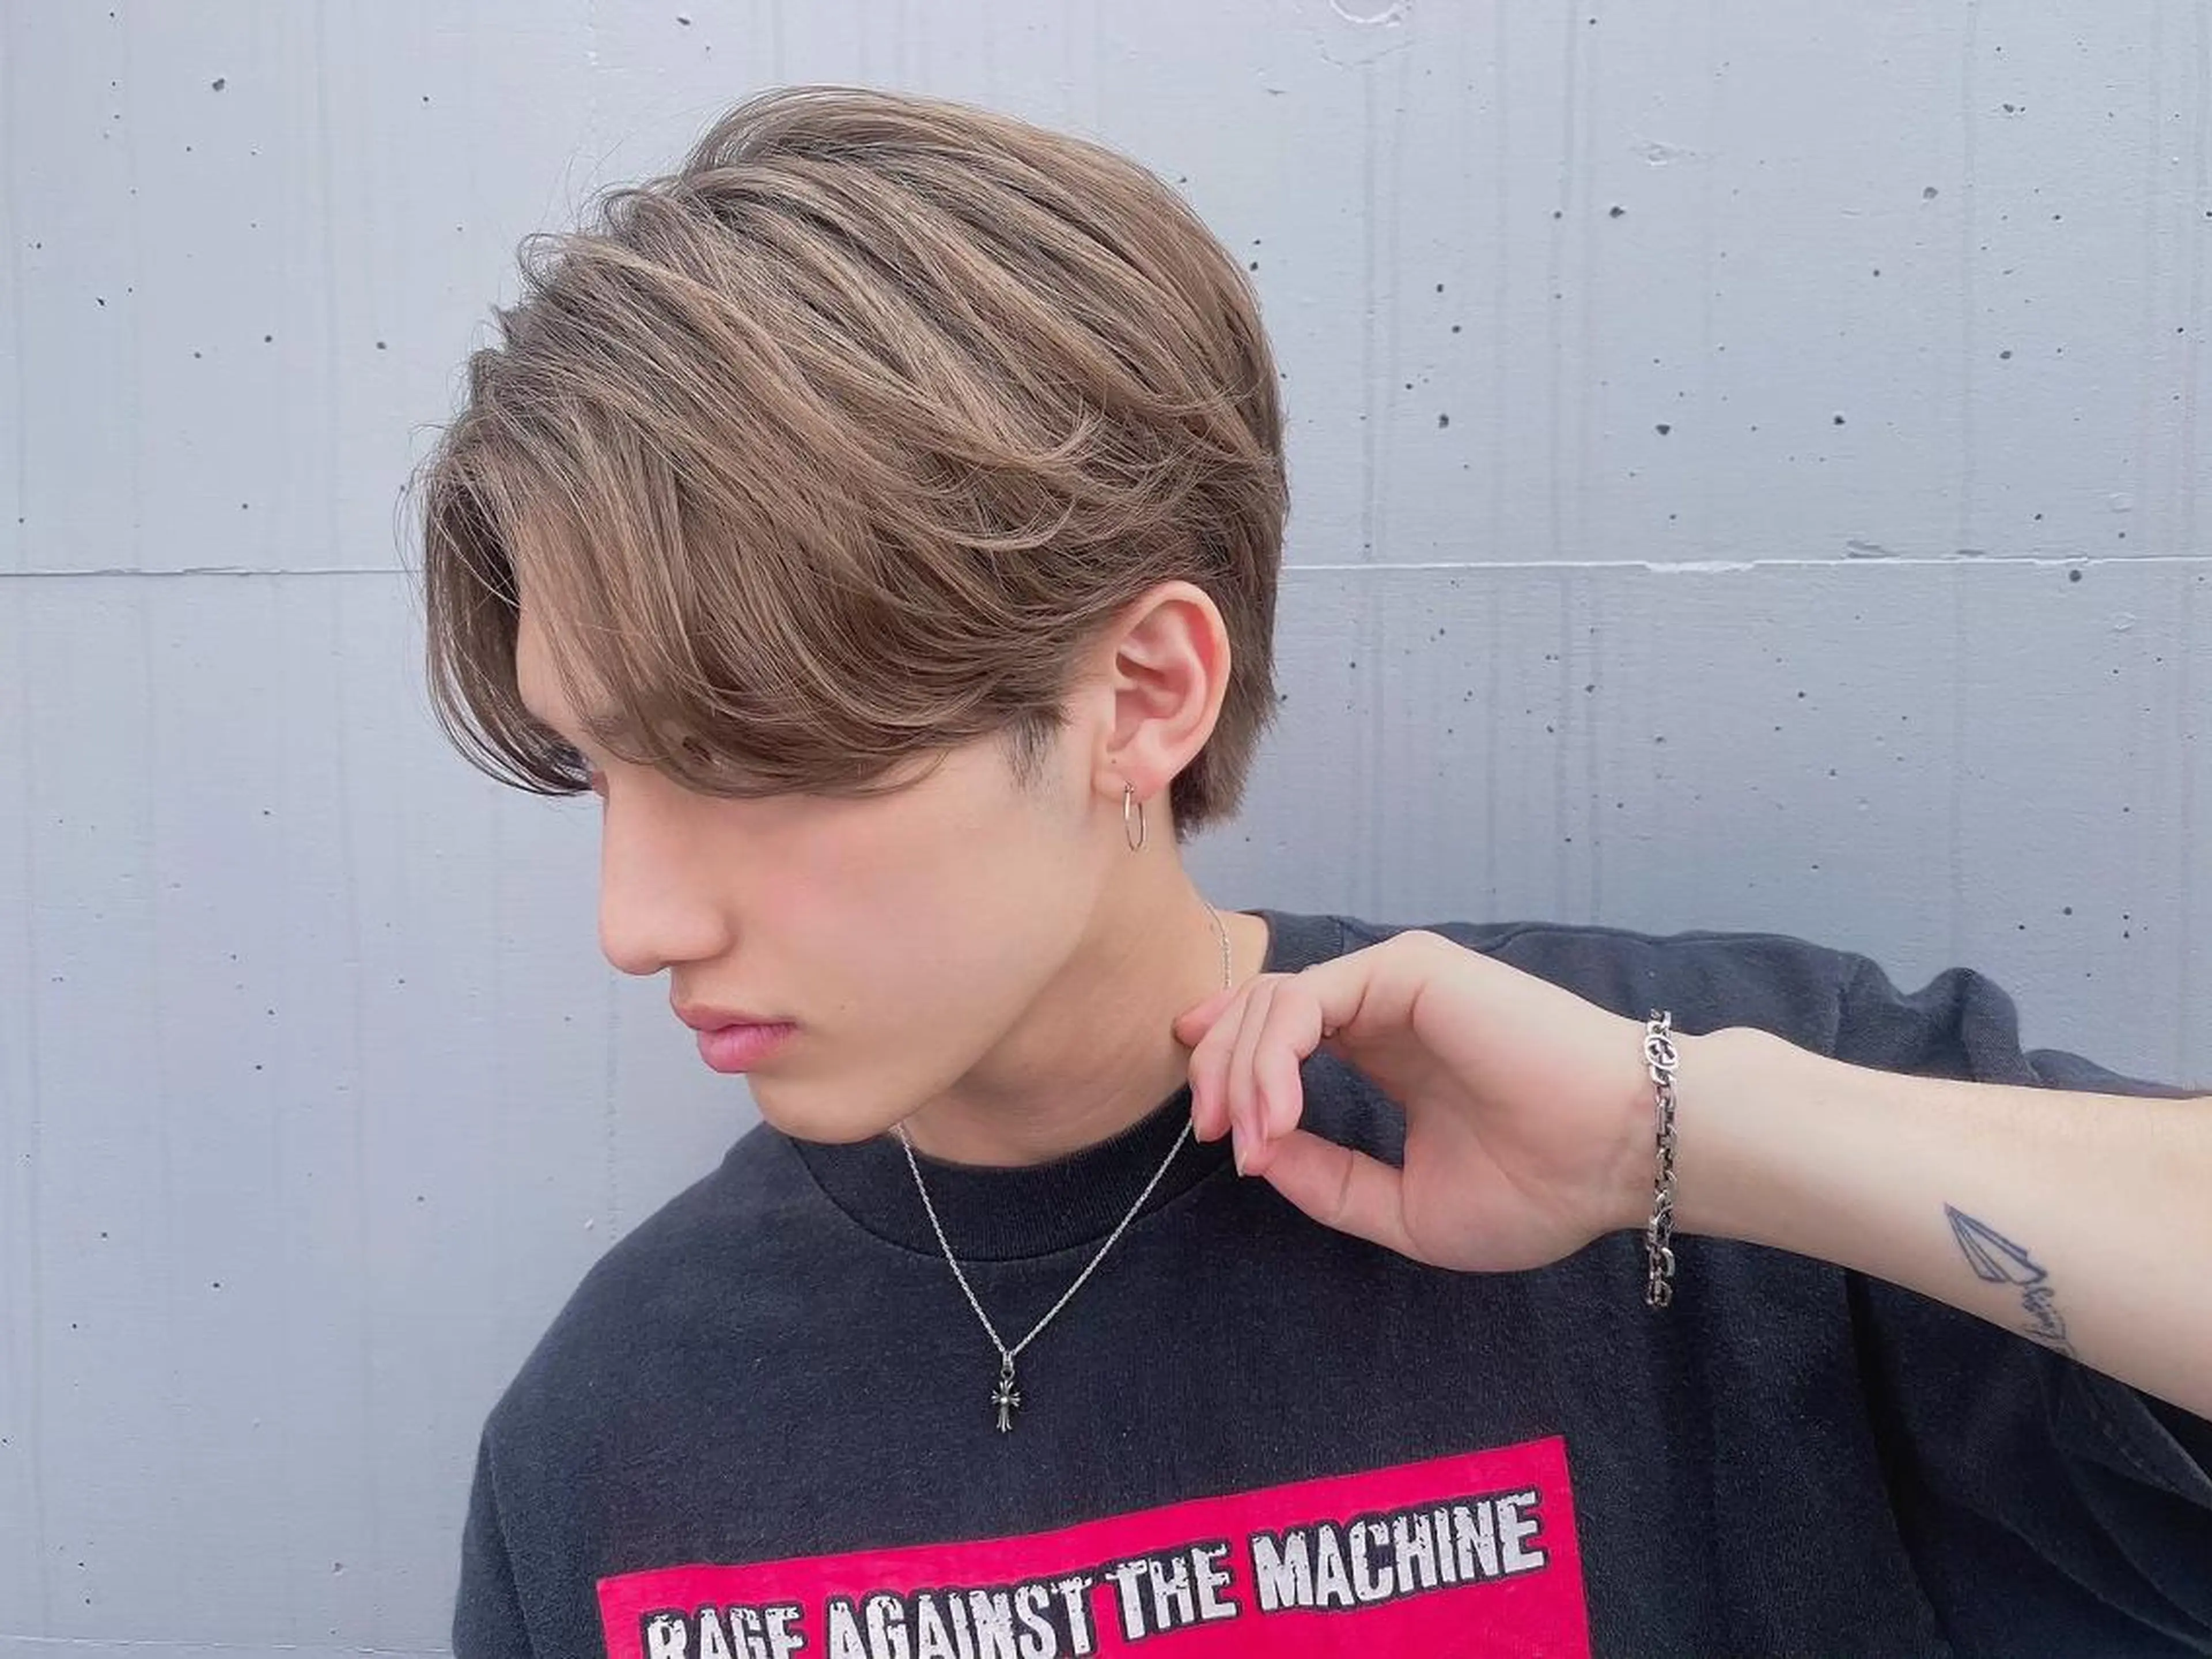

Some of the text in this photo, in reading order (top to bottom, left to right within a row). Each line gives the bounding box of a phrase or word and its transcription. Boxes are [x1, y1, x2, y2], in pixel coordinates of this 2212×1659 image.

[646, 1490, 1545, 1659] RAGE AGAINST THE MACHINE
